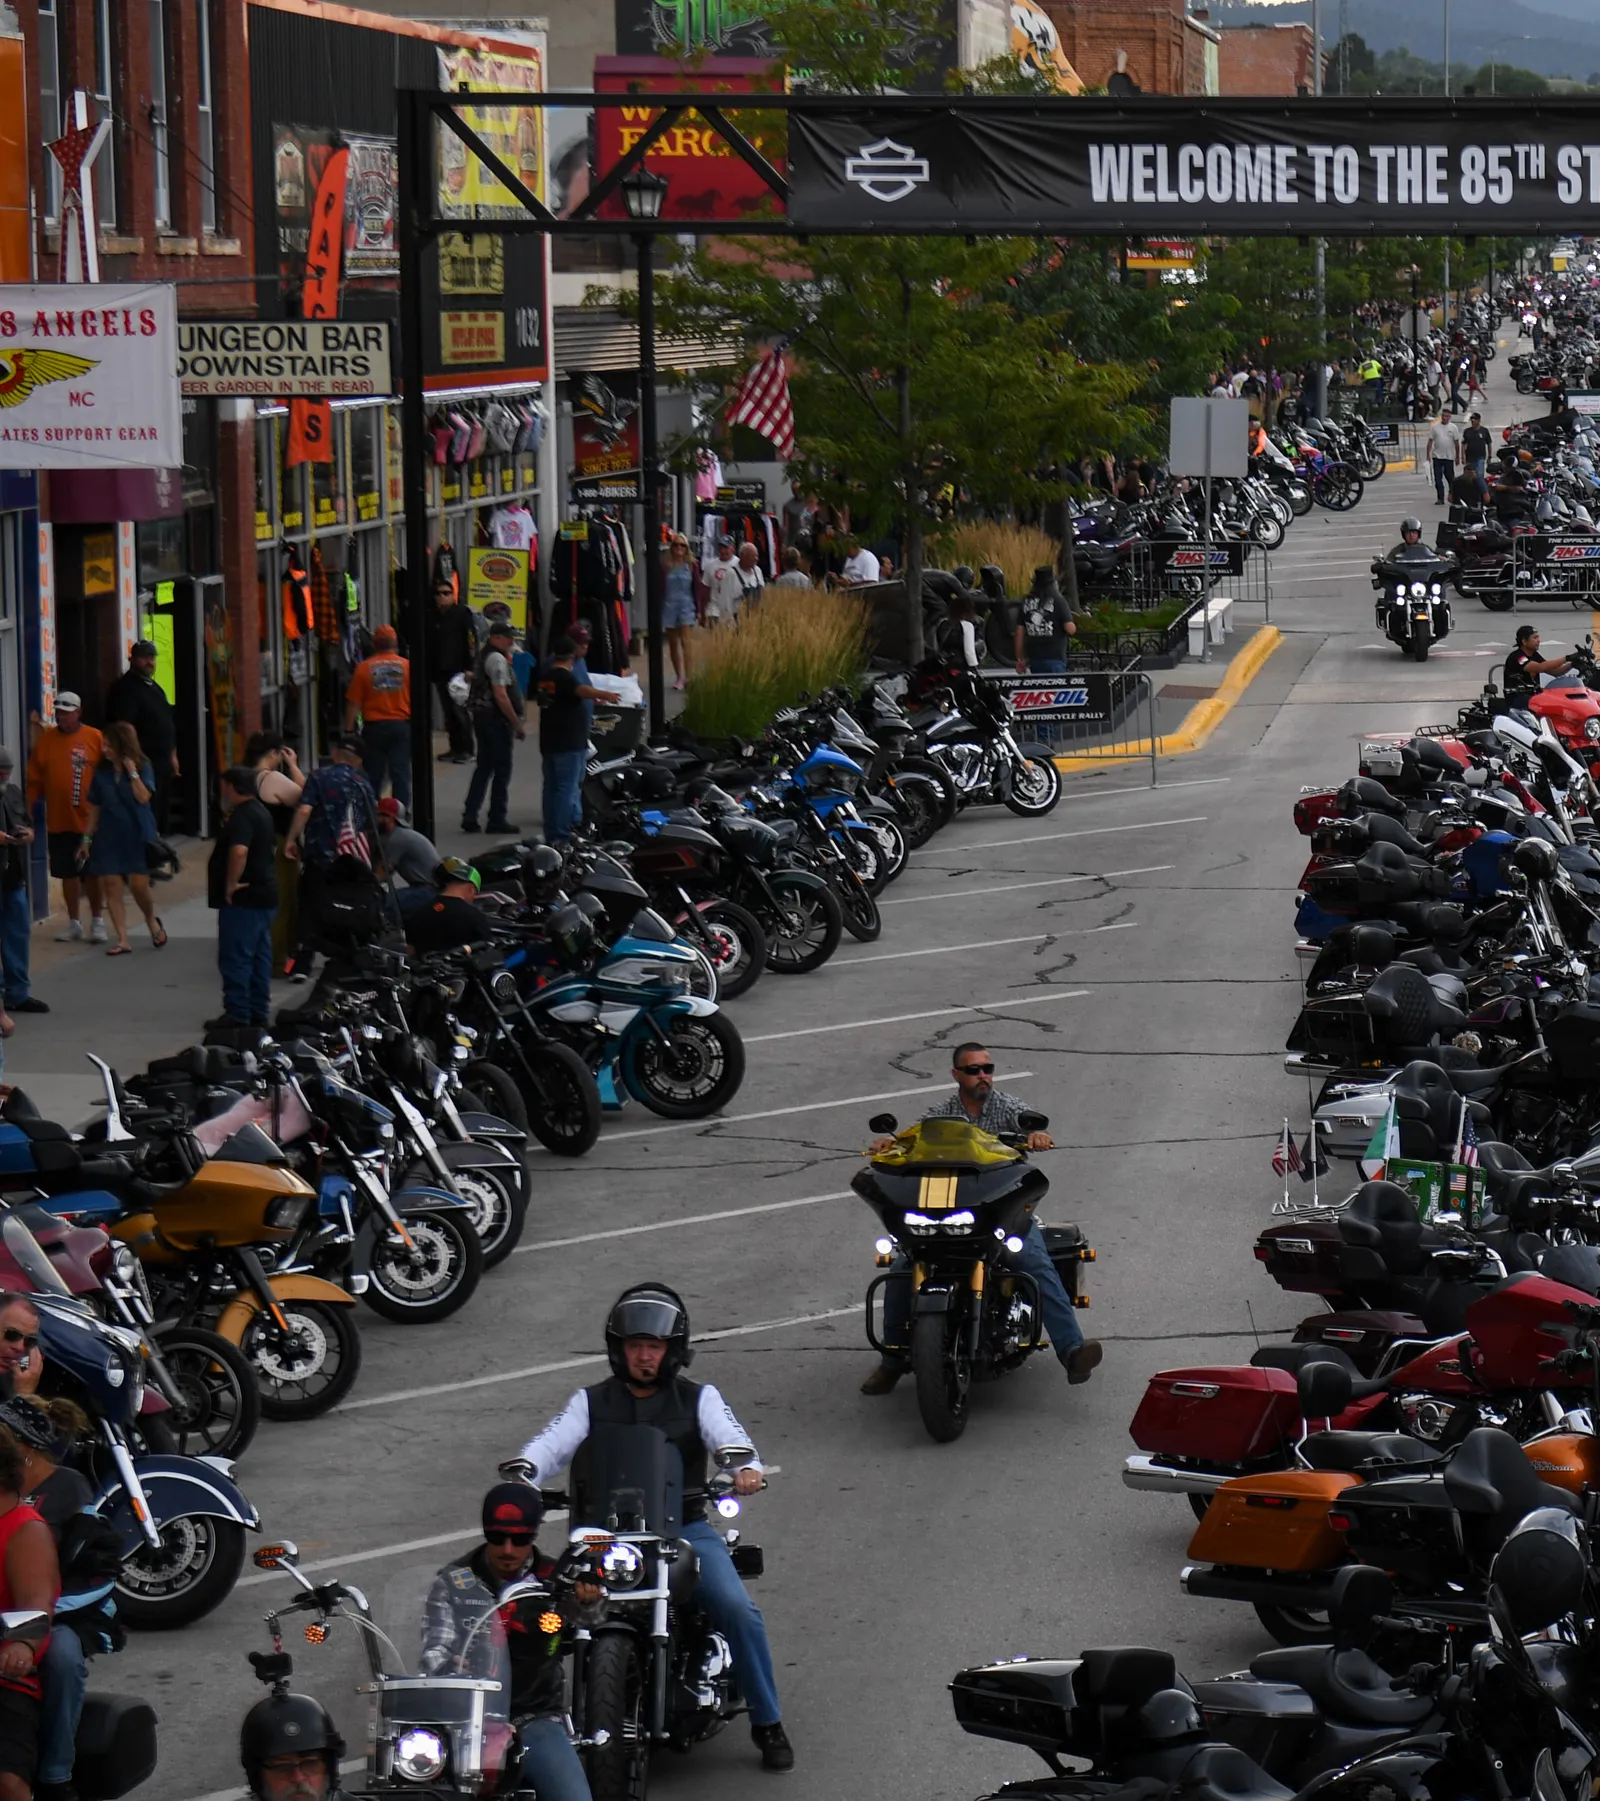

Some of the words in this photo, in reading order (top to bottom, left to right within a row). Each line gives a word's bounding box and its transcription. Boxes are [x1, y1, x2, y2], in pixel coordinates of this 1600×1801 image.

[1088, 144, 1298, 203] WELCOME
[1306, 145, 1359, 204] TO
[1369, 145, 1449, 204] THE
[1460, 143, 1546, 204] 85TH
[32, 308, 157, 337] ANGELS
[178, 325, 308, 352] UNGEON
[323, 325, 383, 352] BAR
[181, 381, 209, 394] EER
[215, 380, 274, 394] GARDEN
[278, 380, 293, 393] IN
[299, 380, 326, 393] THE
[332, 380, 375, 395] REAR)
[69, 391, 95, 407] MC
[45, 427, 113, 441] SUPPORT
[119, 426, 159, 441] GEAR
[39, 529, 53, 718] DUNGEO
[1001, 679, 1022, 687] THE
[1023, 678, 1068, 686] OFFICIAL
[1070, 677, 1086, 685] OIL
[1010, 688, 1089, 711] AMSOIL
[1023, 713, 1077, 721] MOTORCYCLE
[1079, 712, 1105, 720] RALLY
